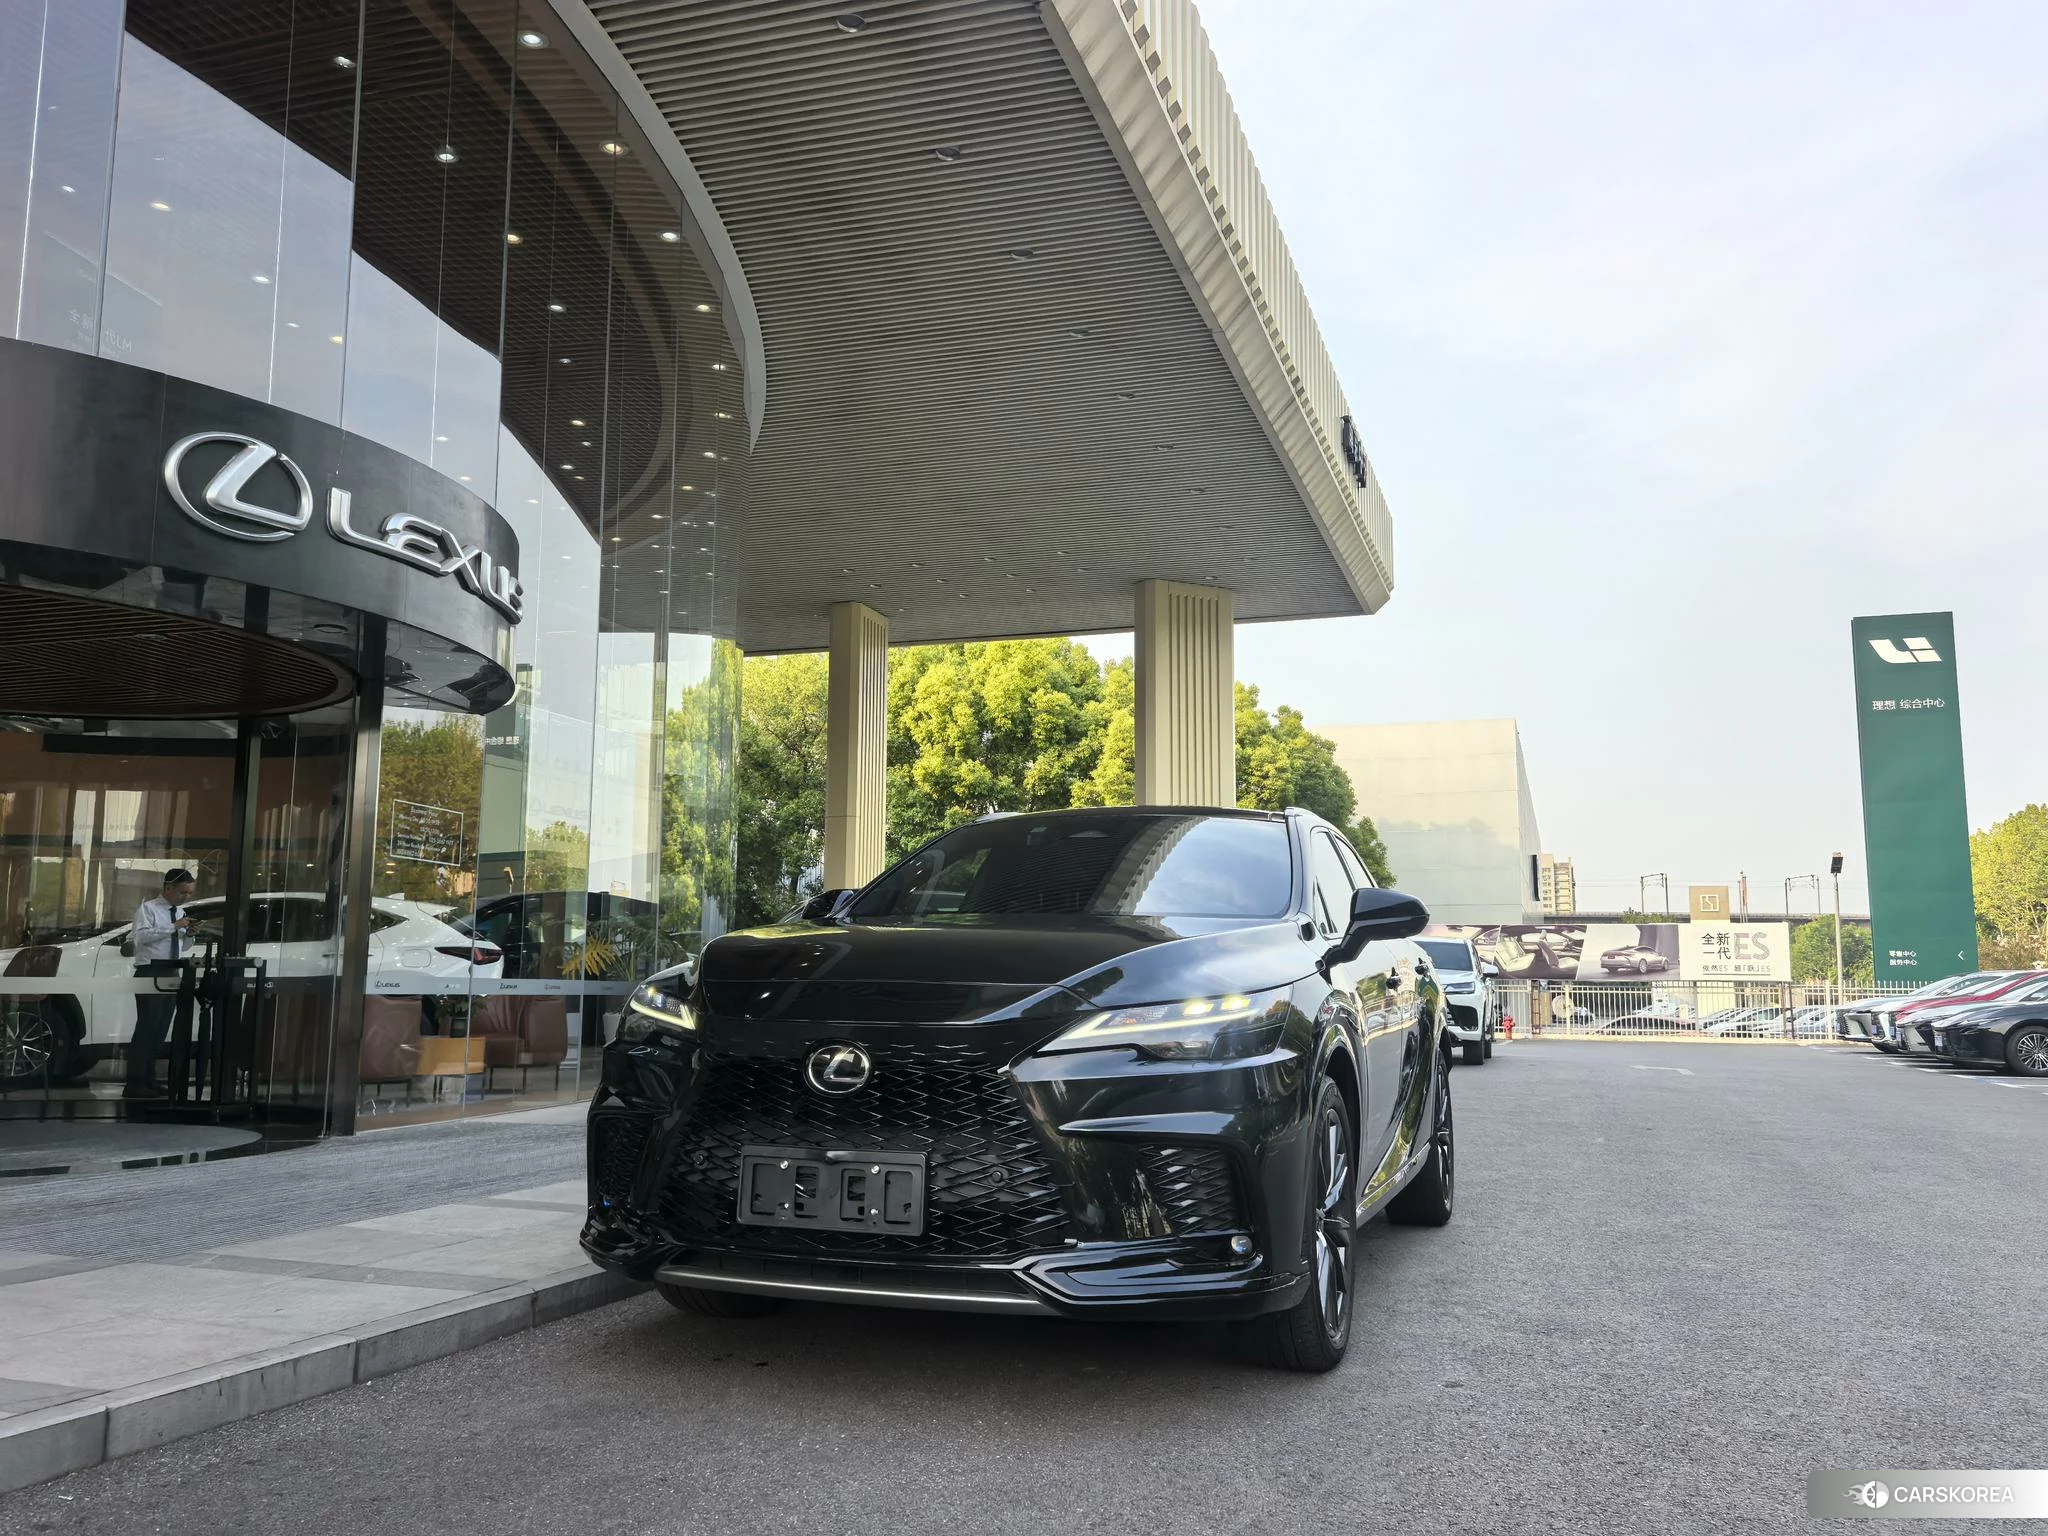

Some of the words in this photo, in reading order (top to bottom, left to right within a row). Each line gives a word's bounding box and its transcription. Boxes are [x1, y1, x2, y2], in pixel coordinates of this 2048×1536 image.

[1900, 698, 1945, 709] 综合中心
[1702, 932, 1730, 946] 全新
[1734, 932, 1770, 960] ES
[1703, 947, 1731, 960] 一代
